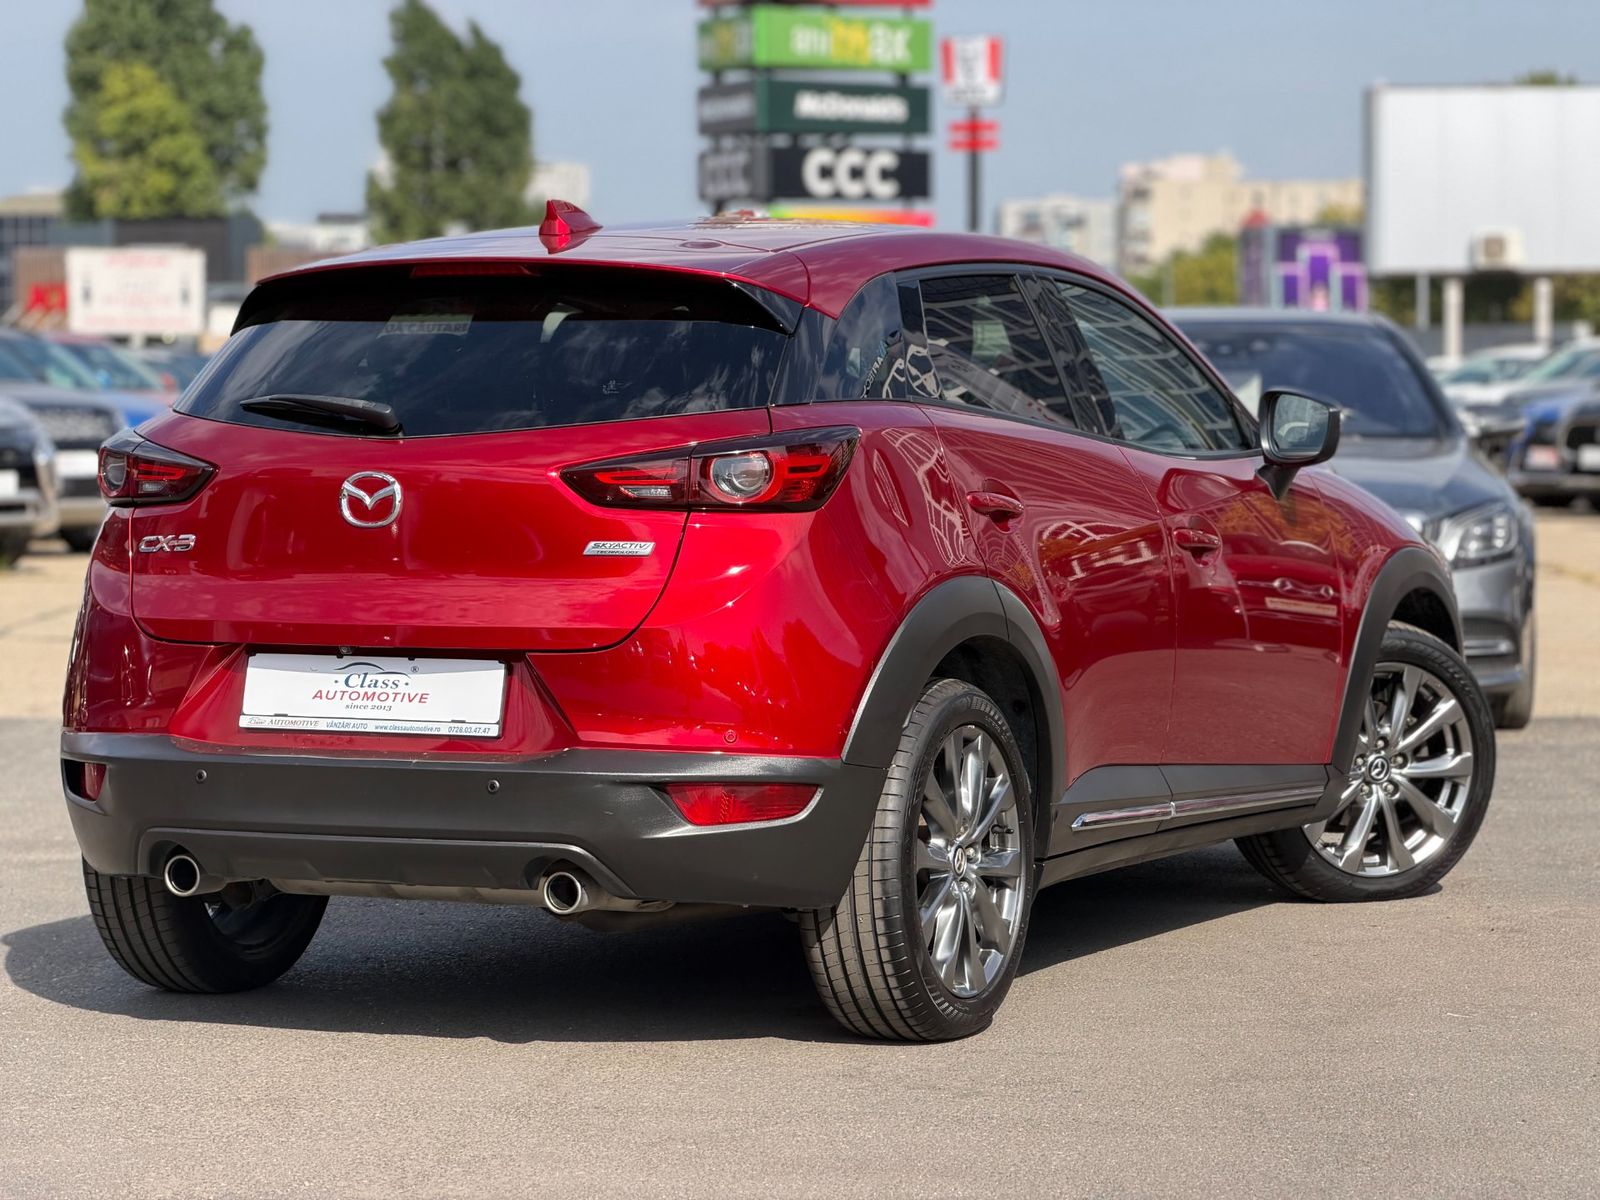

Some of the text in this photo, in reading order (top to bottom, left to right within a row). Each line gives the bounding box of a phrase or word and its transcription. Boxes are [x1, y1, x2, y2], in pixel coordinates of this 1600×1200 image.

[802, 148, 900, 198] CCC
[139, 534, 196, 553] CX-3
[591, 542, 648, 550] SKYACTIV
[344, 672, 400, 689] Class
[312, 690, 430, 704] AUTOMOTIVE
[267, 719, 320, 727] AUTOMOTIVE
[351, 722, 369, 731] AUTO
[374, 723, 441, 733] www.classautomotive.ro
[448, 726, 491, 735] 0728.03.47.47
